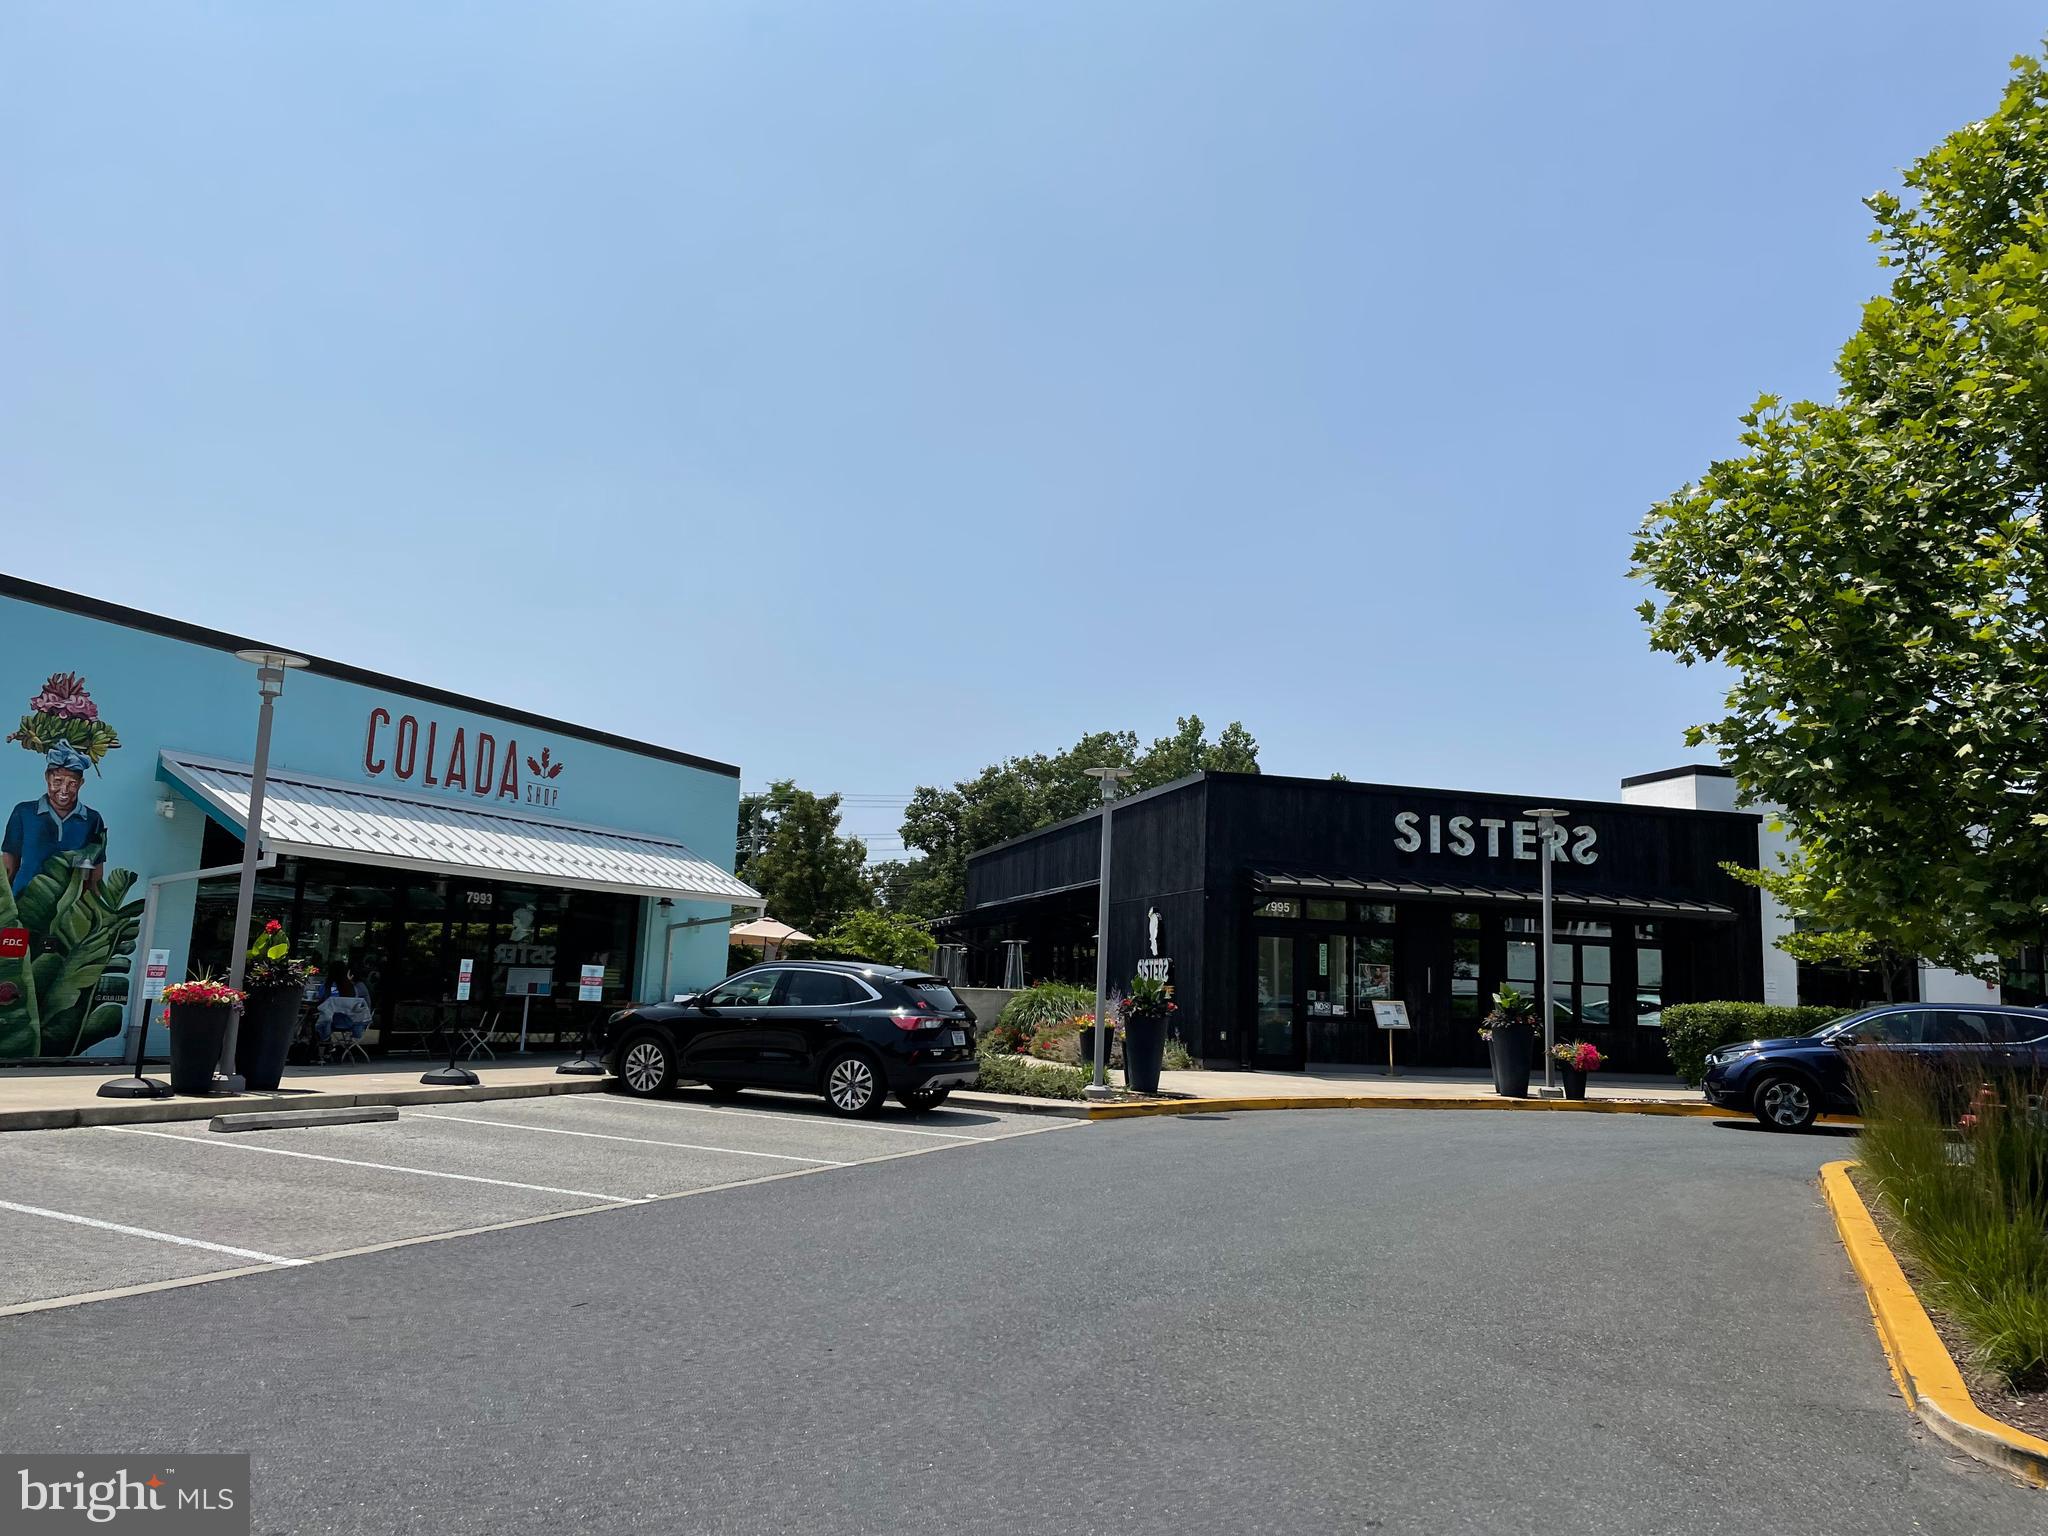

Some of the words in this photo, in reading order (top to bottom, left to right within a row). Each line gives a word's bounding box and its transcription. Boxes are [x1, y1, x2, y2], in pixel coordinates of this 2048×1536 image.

[364, 706, 520, 801] COLADA
[526, 784, 559, 806] SHOP
[1393, 811, 1599, 865] SISTERS
[466, 891, 493, 905] 7993
[1265, 901, 1290, 913] 7995
